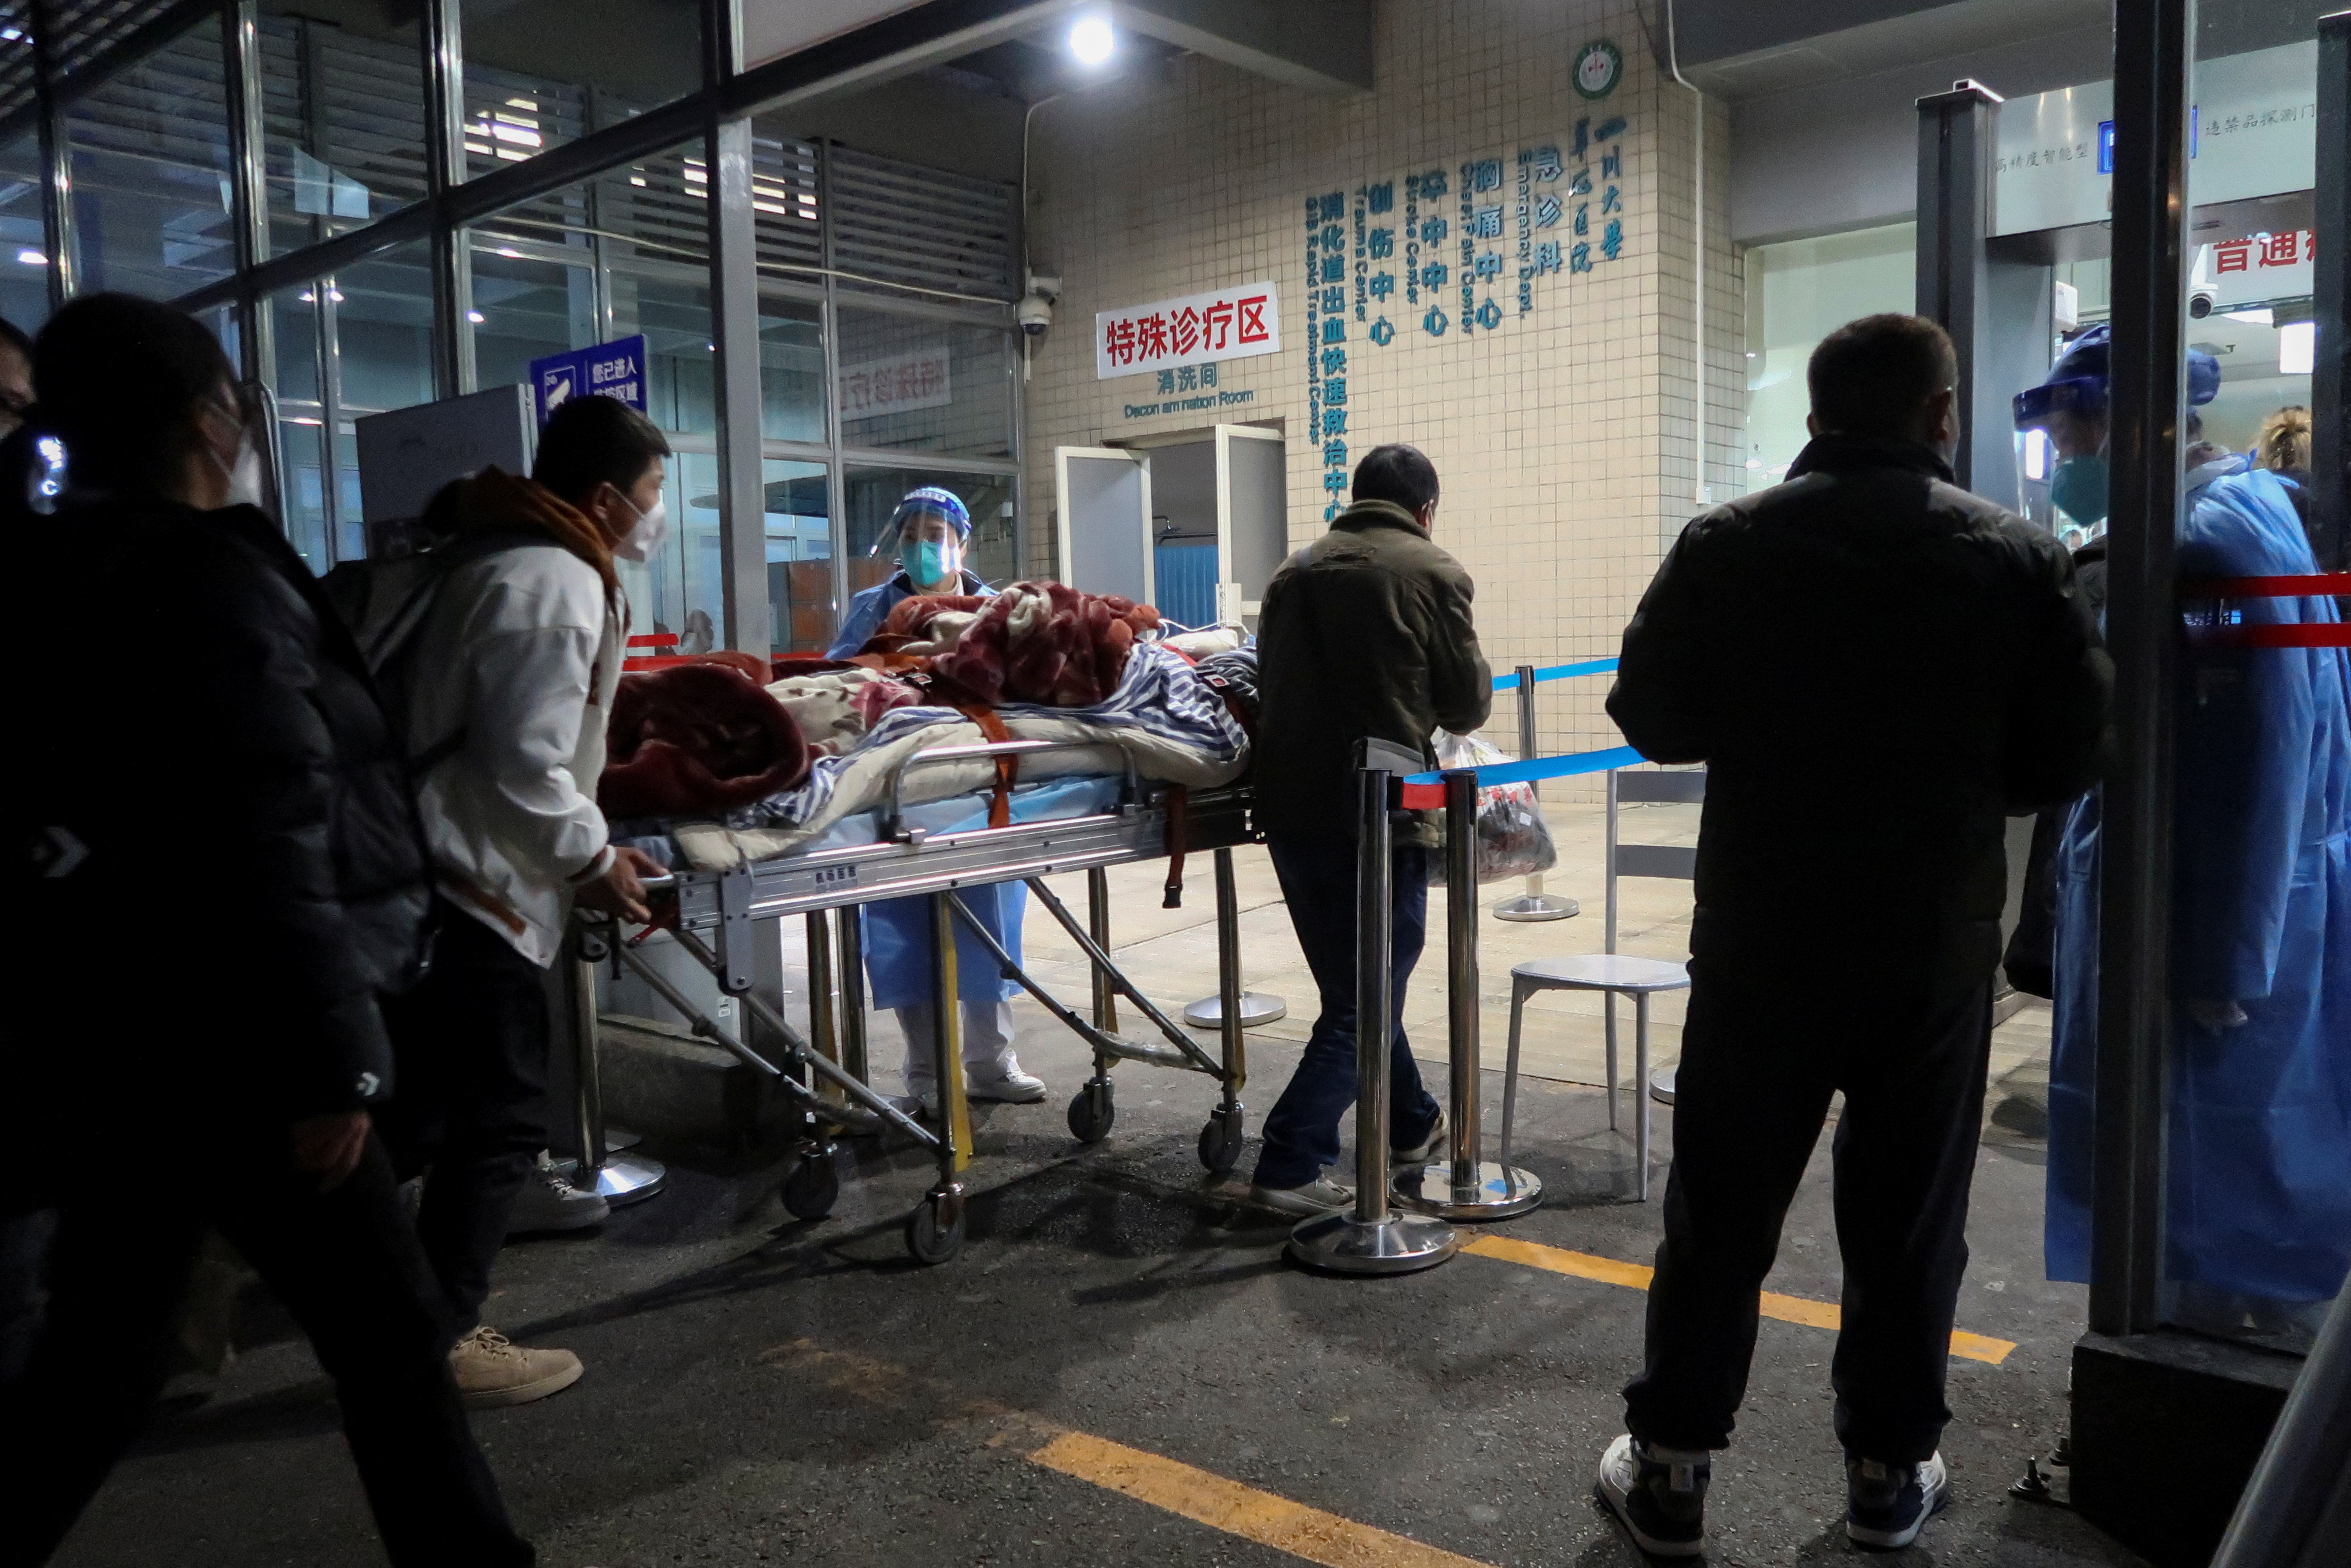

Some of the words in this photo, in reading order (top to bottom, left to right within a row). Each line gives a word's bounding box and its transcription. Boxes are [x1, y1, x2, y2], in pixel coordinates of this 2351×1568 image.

[1107, 295, 1269, 367] 特殊诊疗区
[1219, 390, 1254, 407] Room
